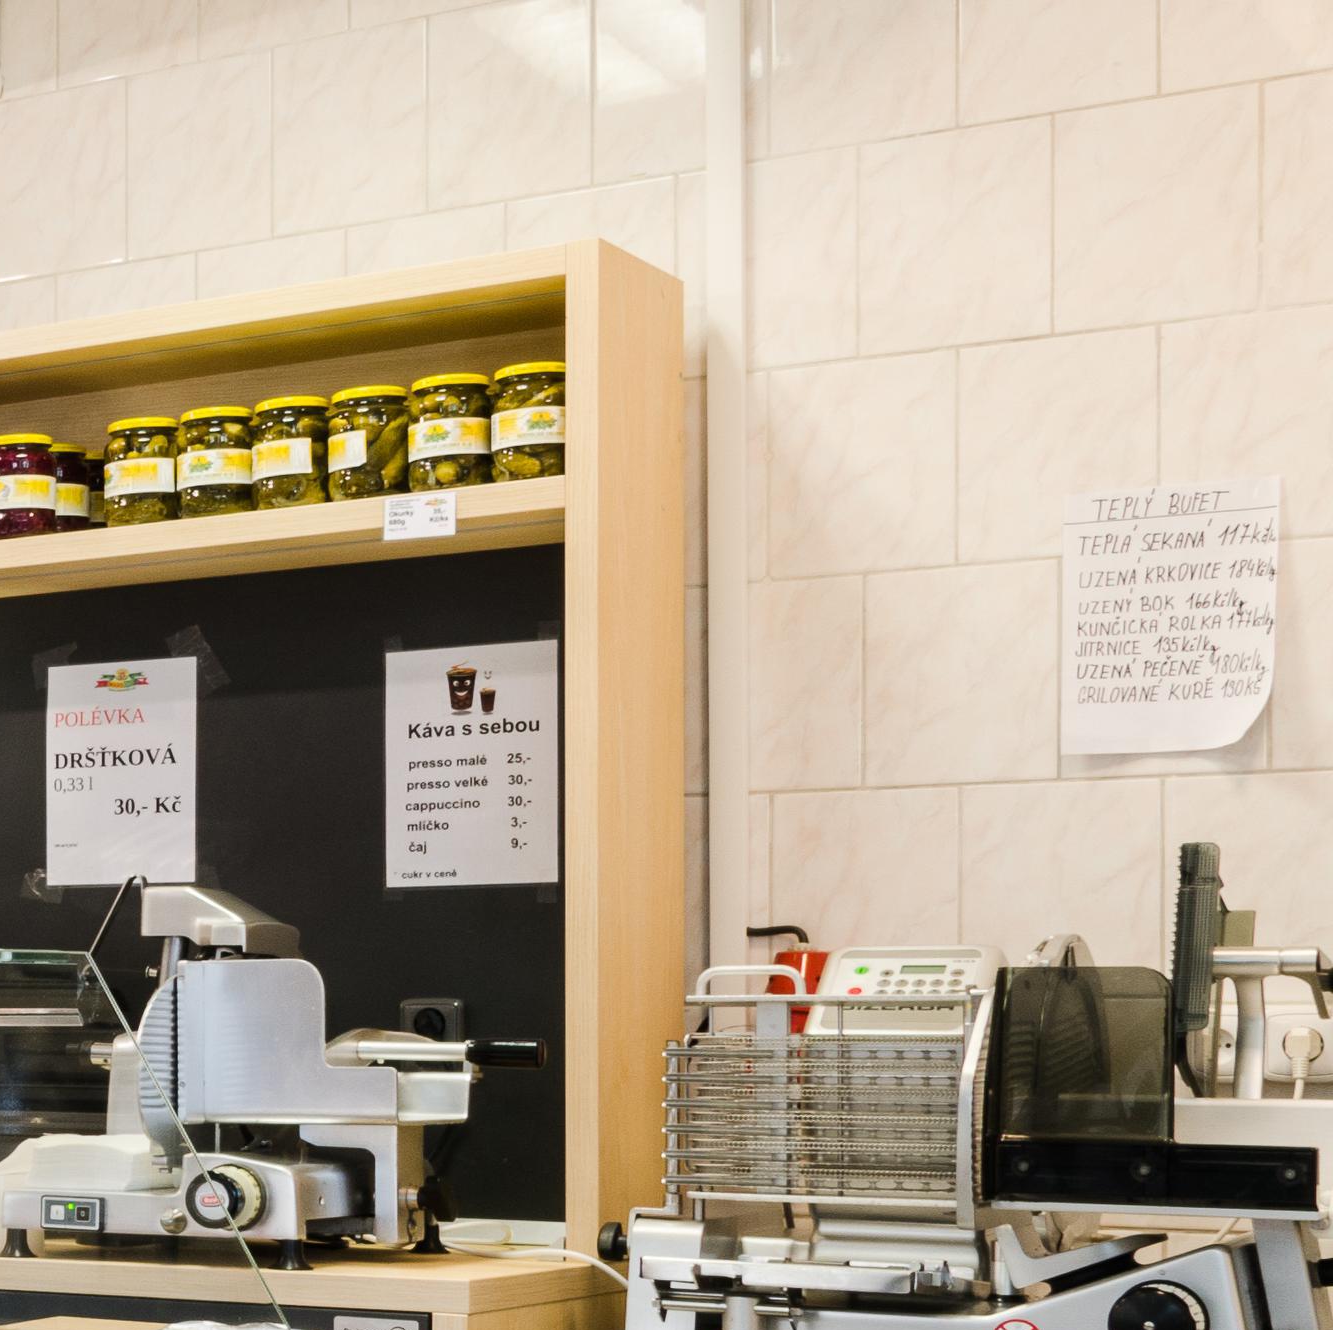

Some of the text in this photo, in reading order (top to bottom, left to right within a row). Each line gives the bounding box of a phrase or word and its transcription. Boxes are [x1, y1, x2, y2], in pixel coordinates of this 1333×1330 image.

[1092, 488, 1229, 521] TEPLÝ BUFET
[1079, 518, 1213, 556] TEPLÁ SEKANÁ
[1079, 557, 1222, 589] UZENÁ KRKOVICE
[1079, 587, 1175, 615] UZENÝ BOK
[1169, 615, 1221, 632] ROLKA
[1075, 640, 1141, 657] JITRNICE
[1077, 658, 1136, 680] UZENÁ
[54, 707, 145, 729] POLÉVKA
[408, 718, 540, 739] Káva s sebou
[54, 742, 177, 770] DRŠŤKOVÁ
[408, 753, 531, 771] presso malé 25,-
[54, 778, 85, 794] 0,33
[406, 774, 532, 793] presso velké 30,-
[114, 796, 182, 816] 30,- Kč
[405, 796, 532, 813] cappuccino 30,-
[407, 817, 527, 832] mlíčko 3,-
[409, 838, 528, 854] čaj 9,-
[401, 869, 423, 879] cukr
